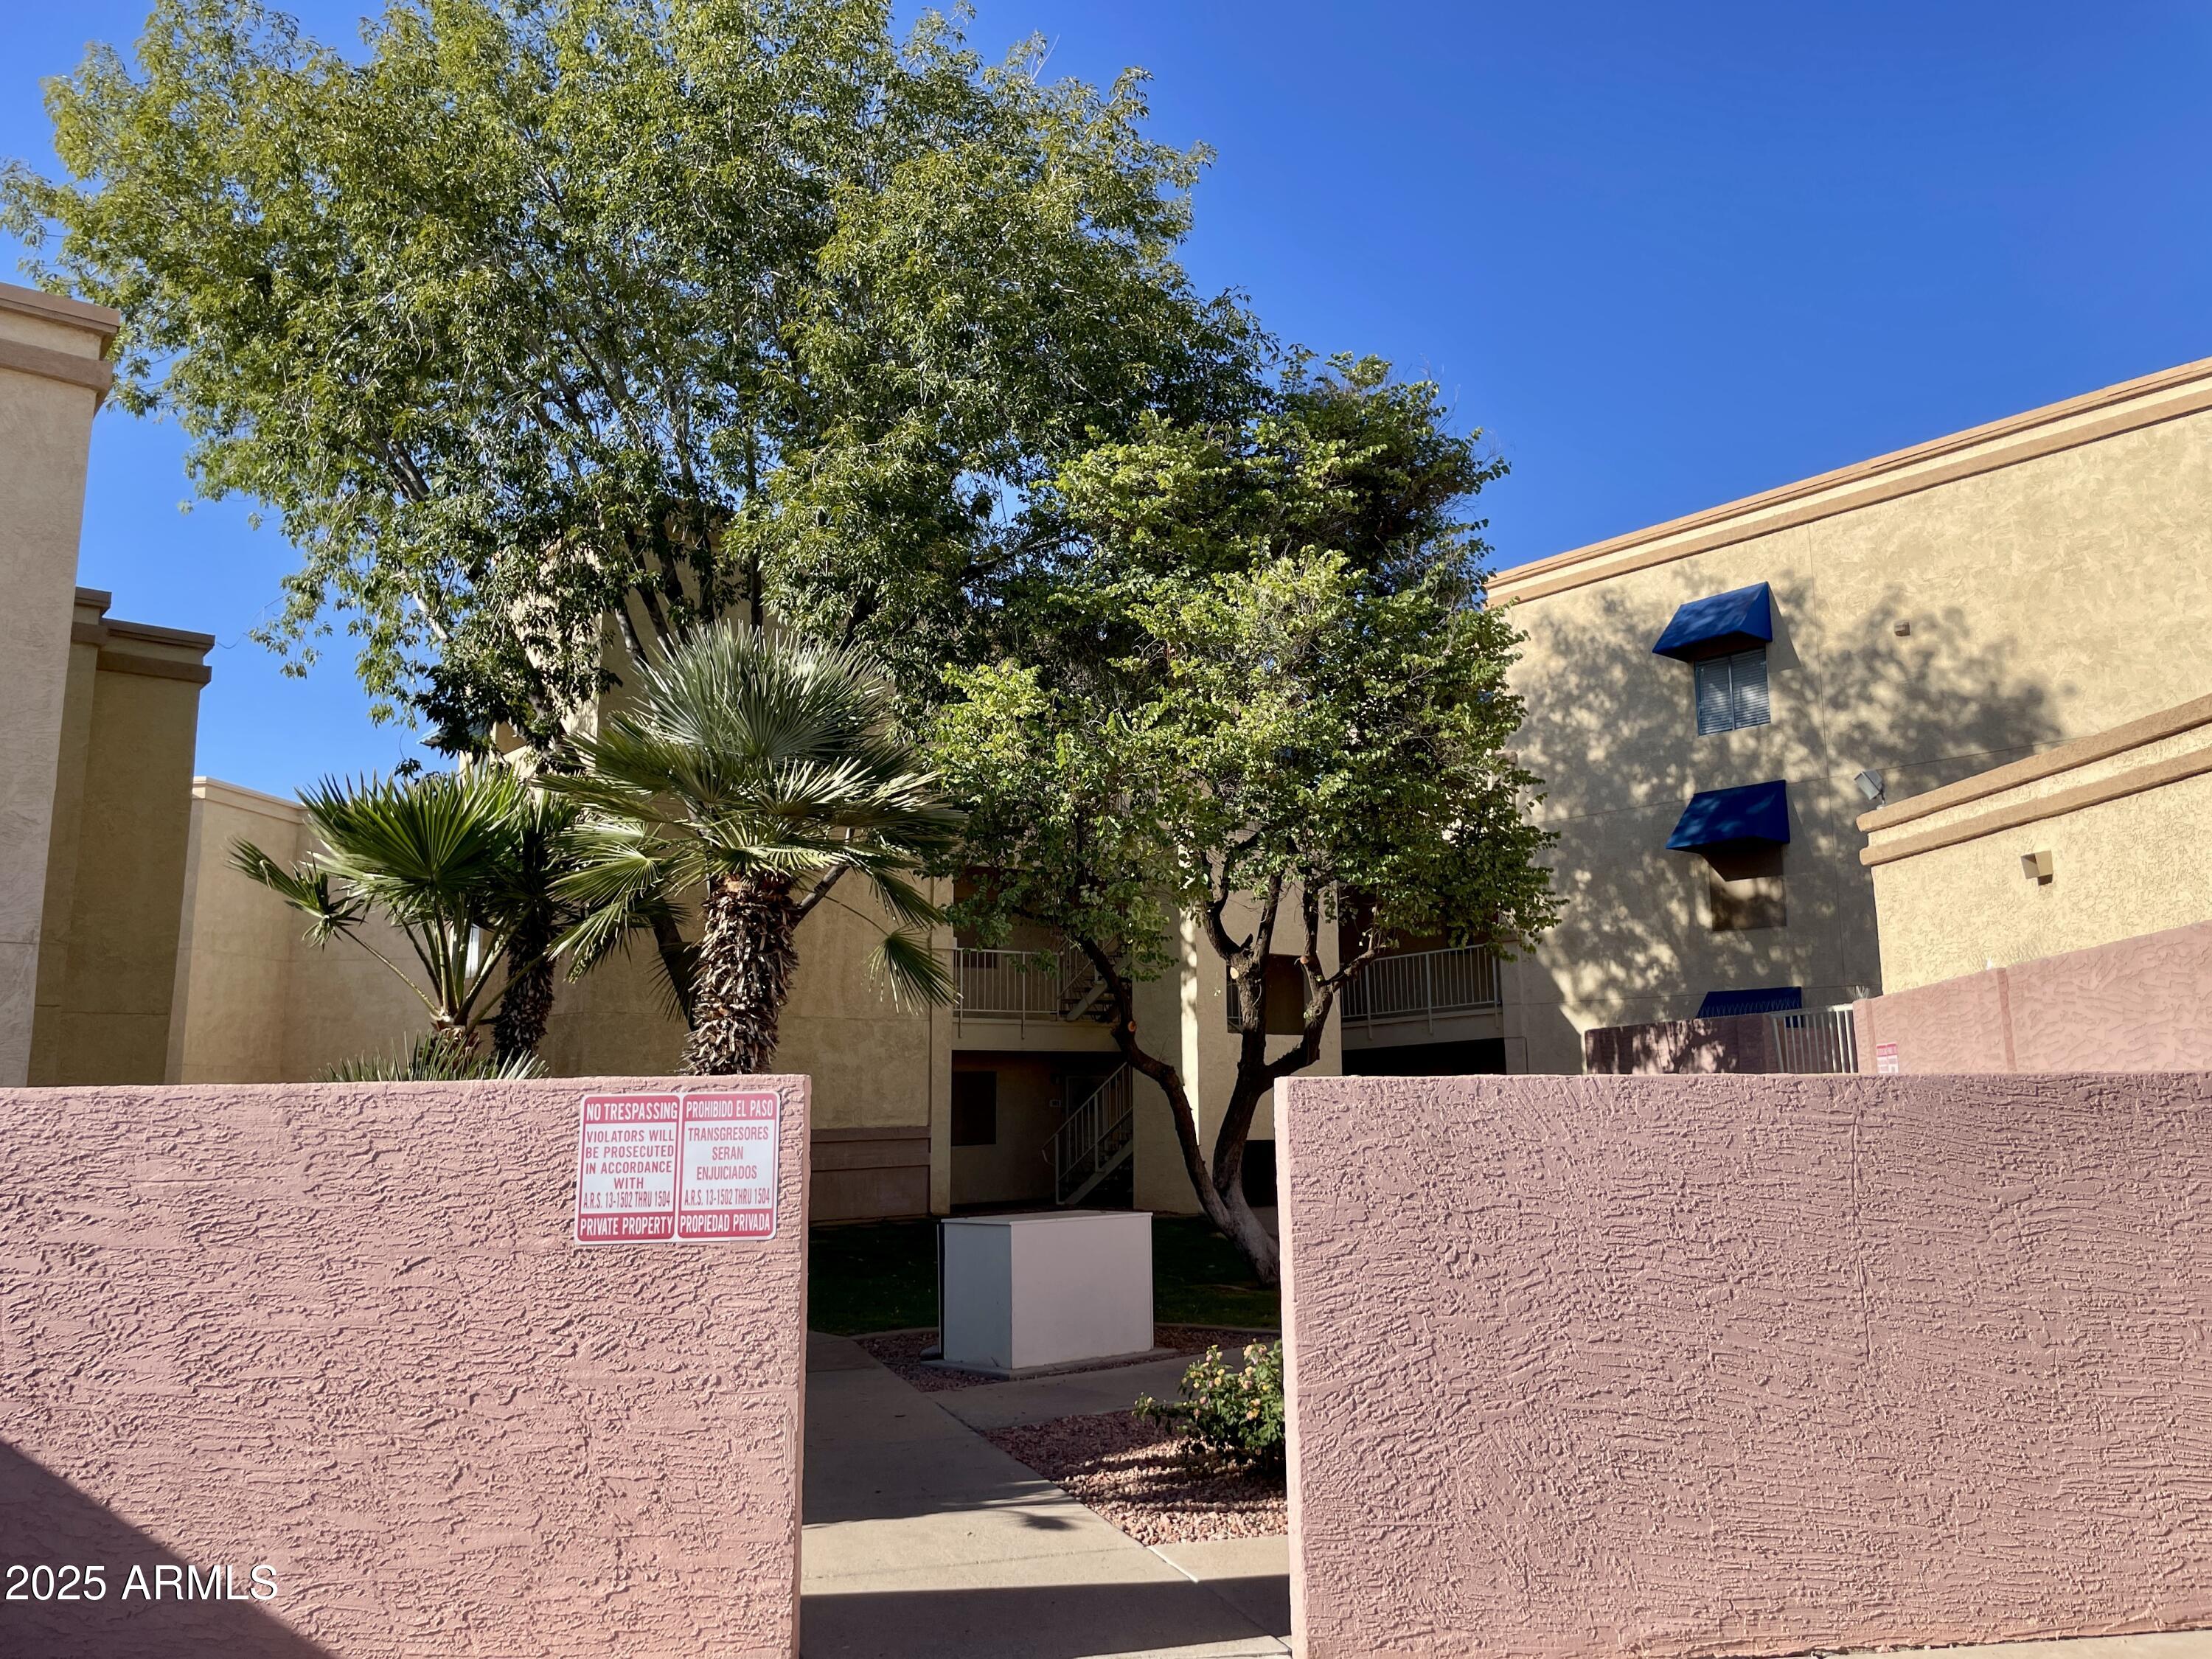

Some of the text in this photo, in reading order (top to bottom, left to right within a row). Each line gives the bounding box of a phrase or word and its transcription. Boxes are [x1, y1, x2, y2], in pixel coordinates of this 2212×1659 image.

[587, 1102, 678, 1121] NO TRESPASSING
[686, 1099, 773, 1118] PROHIBIDO EL PASO
[587, 1130, 674, 1143] VIOLATORS WILL
[689, 1127, 768, 1141] TRANSGRESORES
[585, 1146, 674, 1158] BE PROSECUTED
[712, 1147, 743, 1160] SERAN
[586, 1161, 672, 1174] IN ACCORDANCE
[697, 1165, 757, 1180] ENJUICIADOS
[613, 1178, 644, 1189] WITH
[584, 1192, 670, 1208] A.R.S. 13-1502 THRU 1504
[684, 1188, 770, 1206] A.R.S. 13-1502 THRU 1504
[580, 1216, 672, 1236] PRIVATE PROPERTY
[680, 1213, 770, 1233] PROPIEDAD PRIVADA
